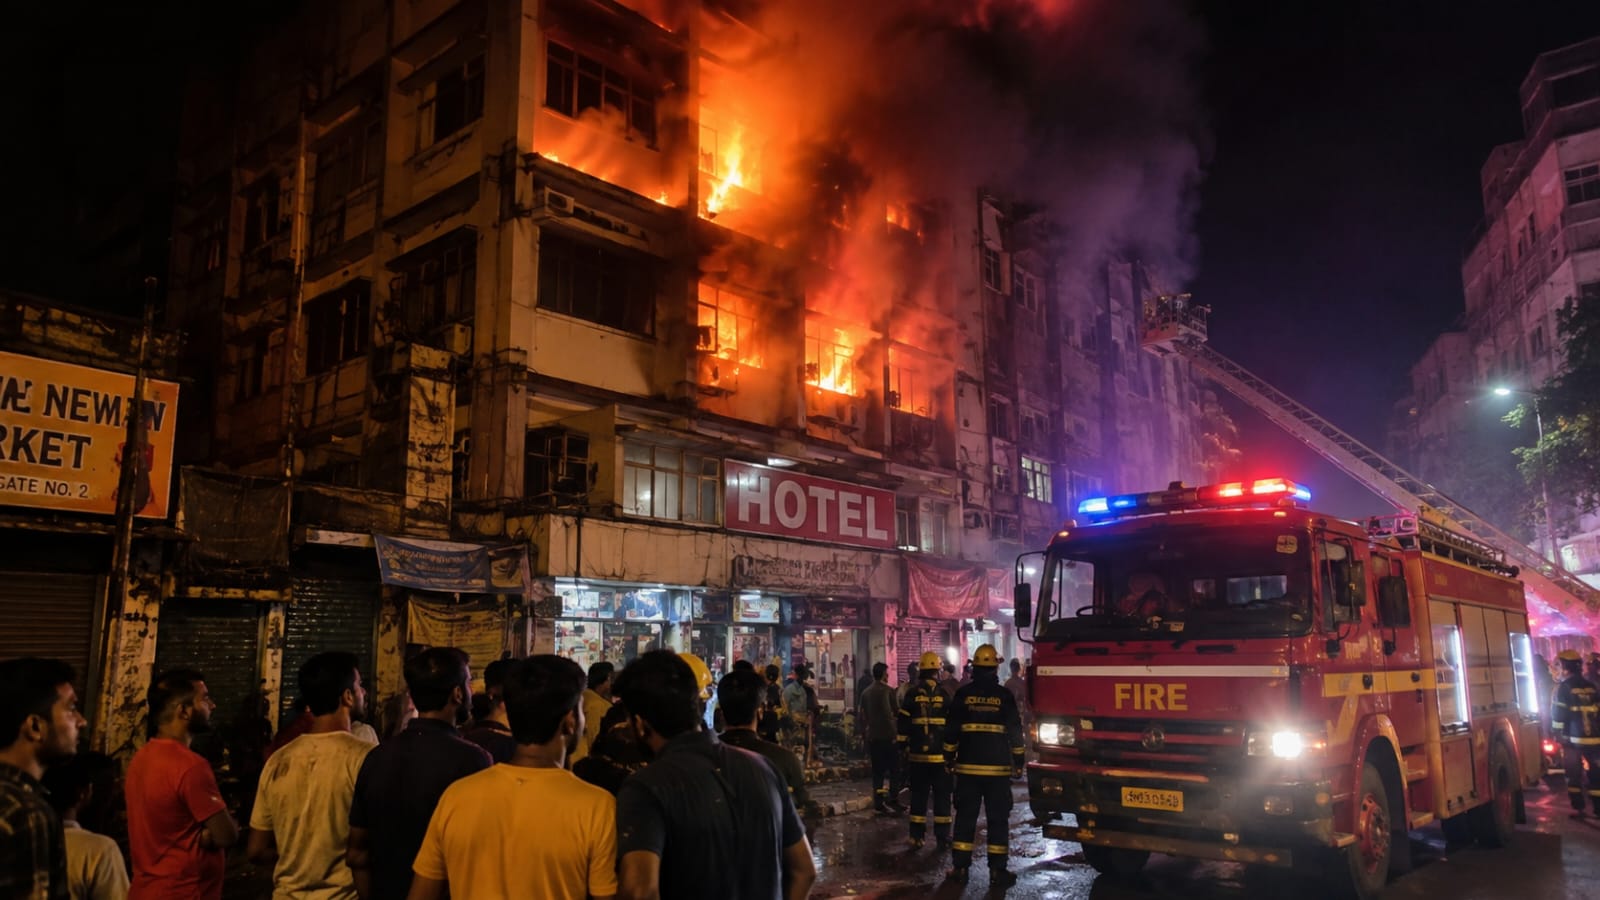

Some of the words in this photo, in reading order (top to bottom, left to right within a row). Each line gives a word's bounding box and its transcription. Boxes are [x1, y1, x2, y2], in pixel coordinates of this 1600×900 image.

[45, 481, 72, 497] NO.
[79, 484, 88, 499] 2
[738, 472, 888, 541] HOTEL
[1114, 683, 1188, 711] FIRE
